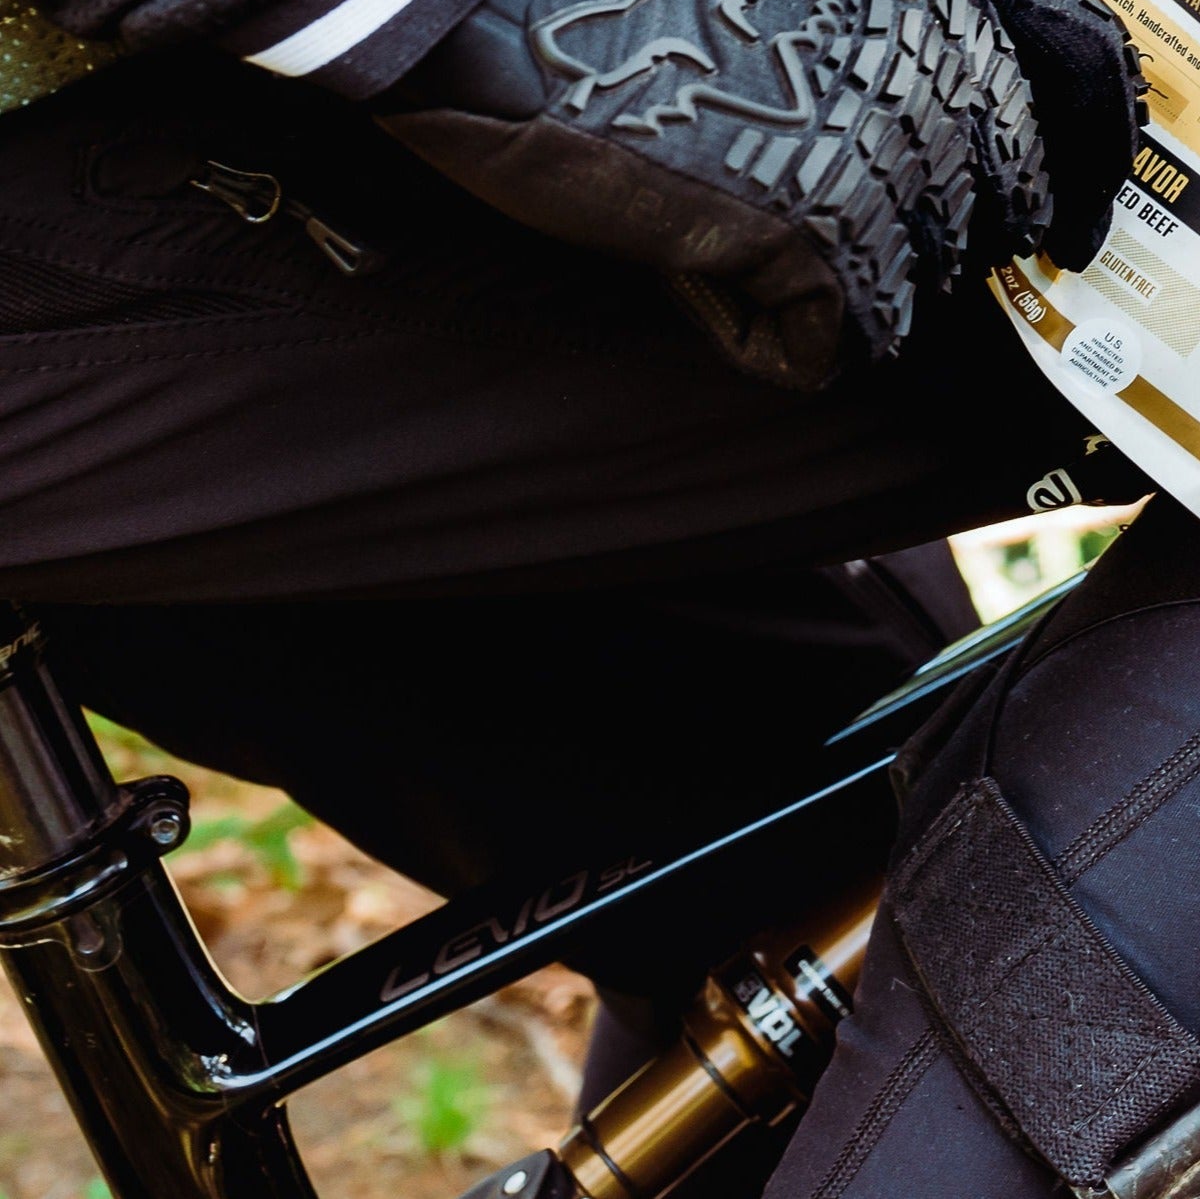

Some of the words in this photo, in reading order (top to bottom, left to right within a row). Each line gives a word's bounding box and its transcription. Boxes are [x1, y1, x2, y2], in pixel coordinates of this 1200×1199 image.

[1136, 9, 1189, 57] Handcrafted
[1187, 53, 1200, 71] and
[1137, 202, 1179, 237] BEEF
[1100, 250, 1135, 283] GLUTEN
[1131, 275, 1156, 299] FREE
[1079, 340, 1092, 353] AND
[1092, 349, 1117, 372] PASSED
[1114, 367, 1124, 376] BY
[1091, 337, 1124, 364] INSPECTED
[1105, 331, 1123, 351] U.S.
[1069, 357, 1108, 389] AGRICULTURE
[1071, 346, 1110, 378] DEPARTMENT
[1108, 373, 1119, 383] OF
[734, 974, 803, 1058] EVOL
